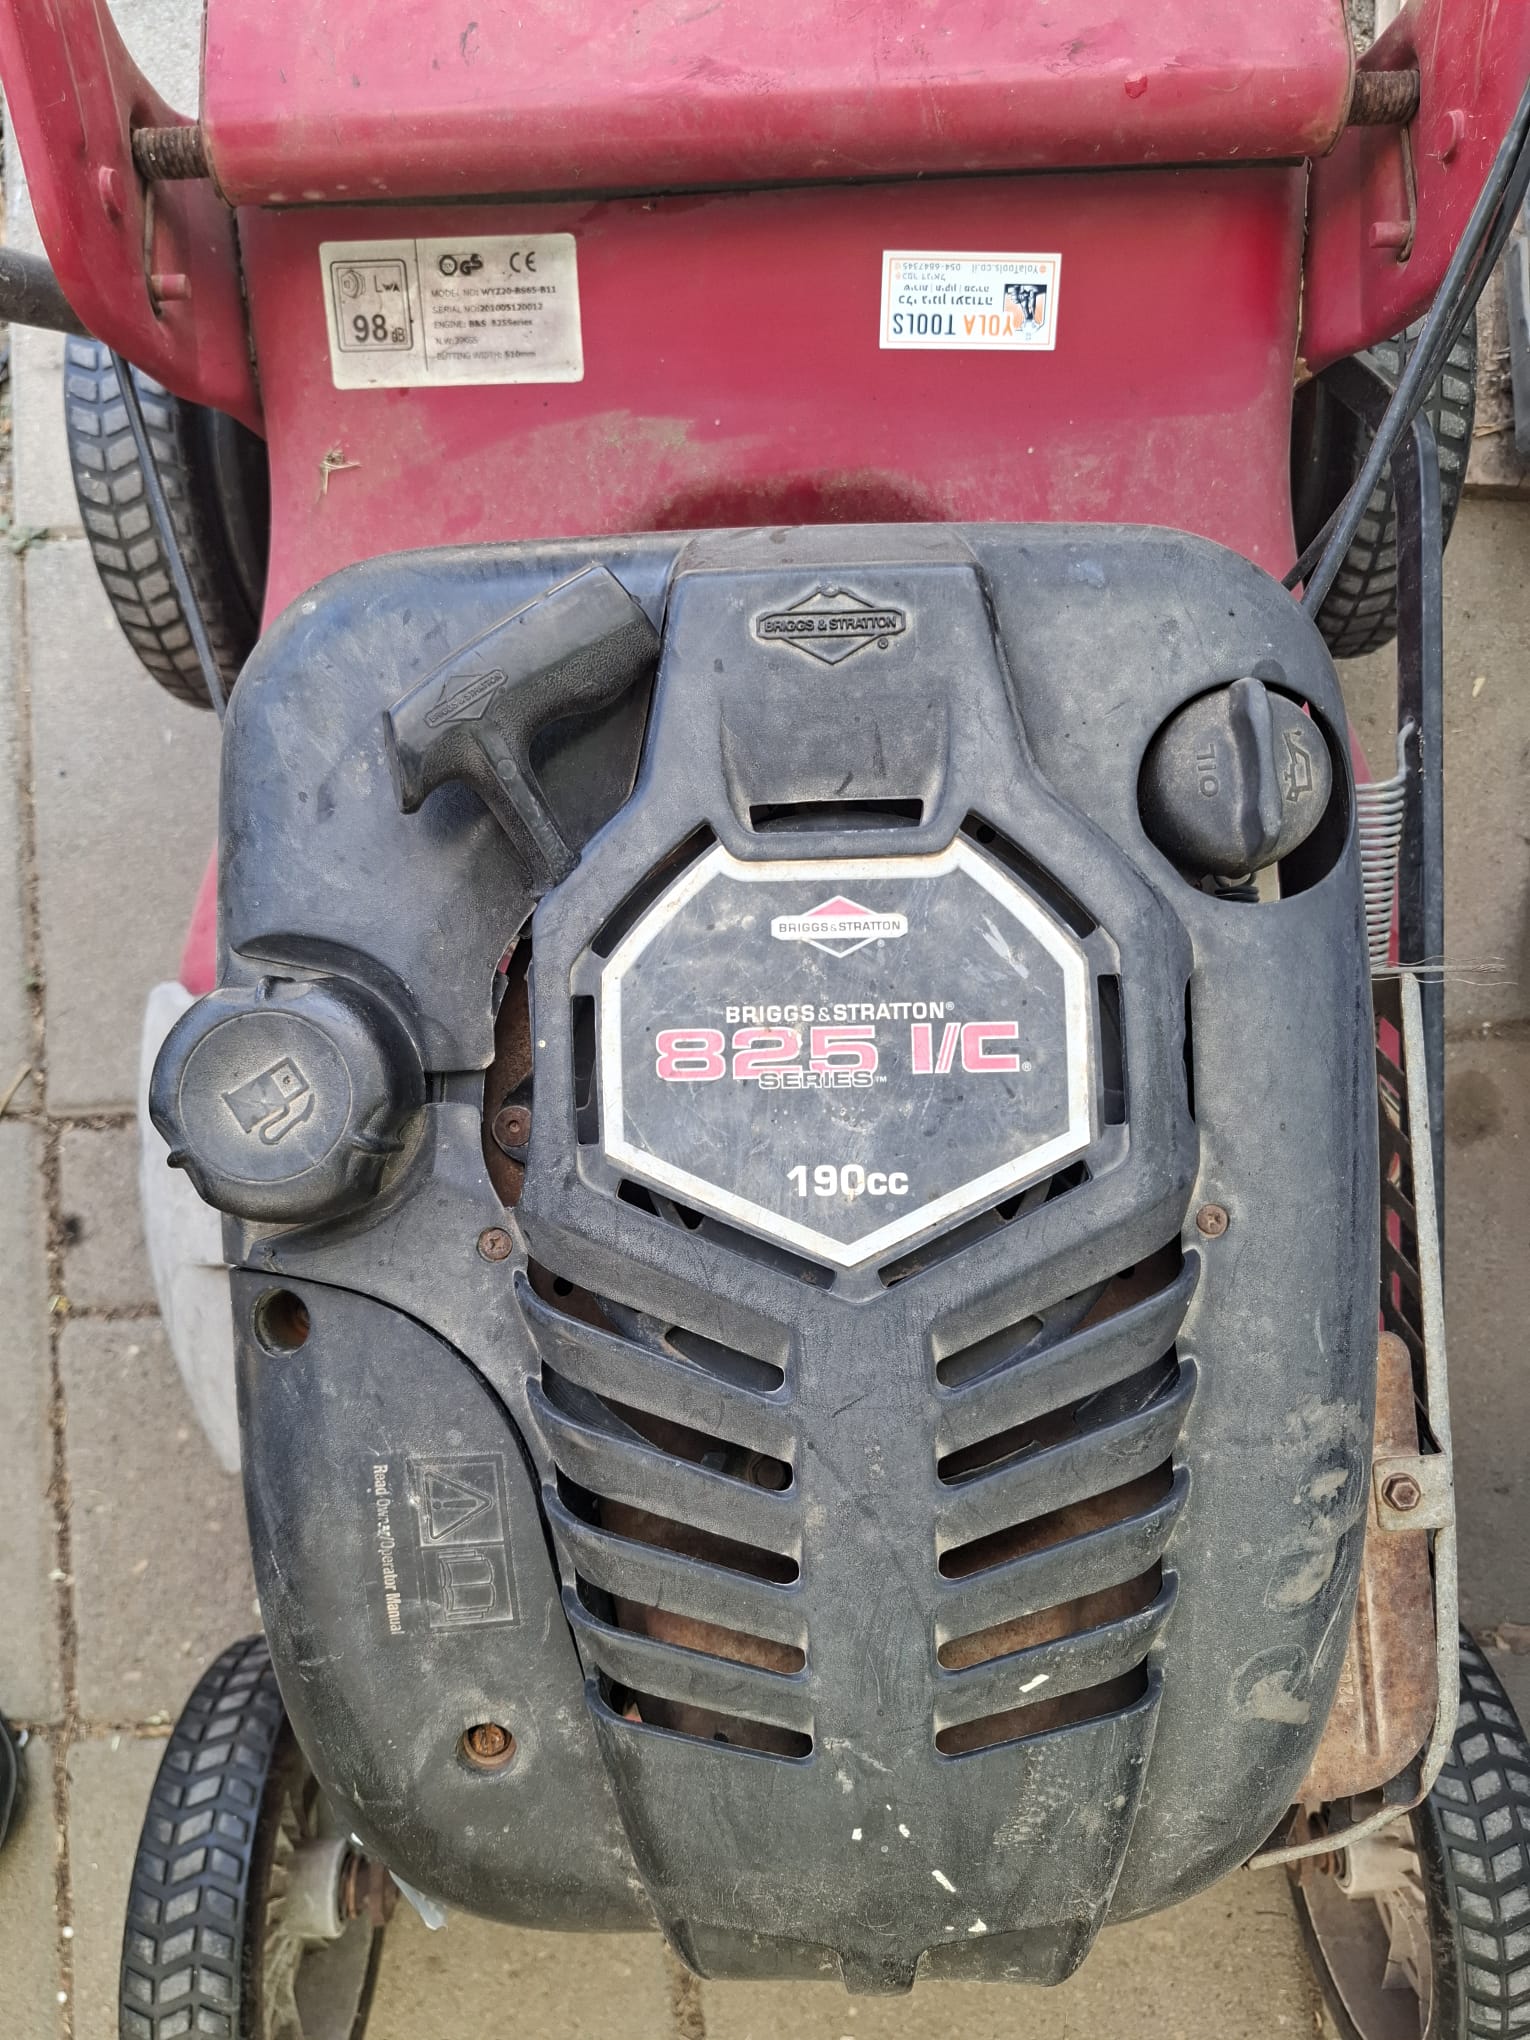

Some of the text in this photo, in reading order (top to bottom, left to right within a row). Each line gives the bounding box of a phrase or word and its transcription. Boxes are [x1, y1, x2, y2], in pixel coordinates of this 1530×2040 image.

[509, 251, 537, 273] CE
[432, 305, 462, 314] SERIAL
[898, 293, 993, 306] כלי גינון ועבודה
[353, 314, 388, 343] 98
[893, 313, 1013, 337] YOLA TOOLS
[764, 619, 815, 633] BRIGGS
[829, 616, 897, 630] STRATTON
[1196, 743, 1219, 798] OIL
[655, 1025, 879, 1083] 825
[758, 1070, 874, 1091] SERIES
[786, 1163, 909, 1198] 190cc
[373, 1464, 391, 1496] Read
[385, 1592, 405, 1635] Manual
